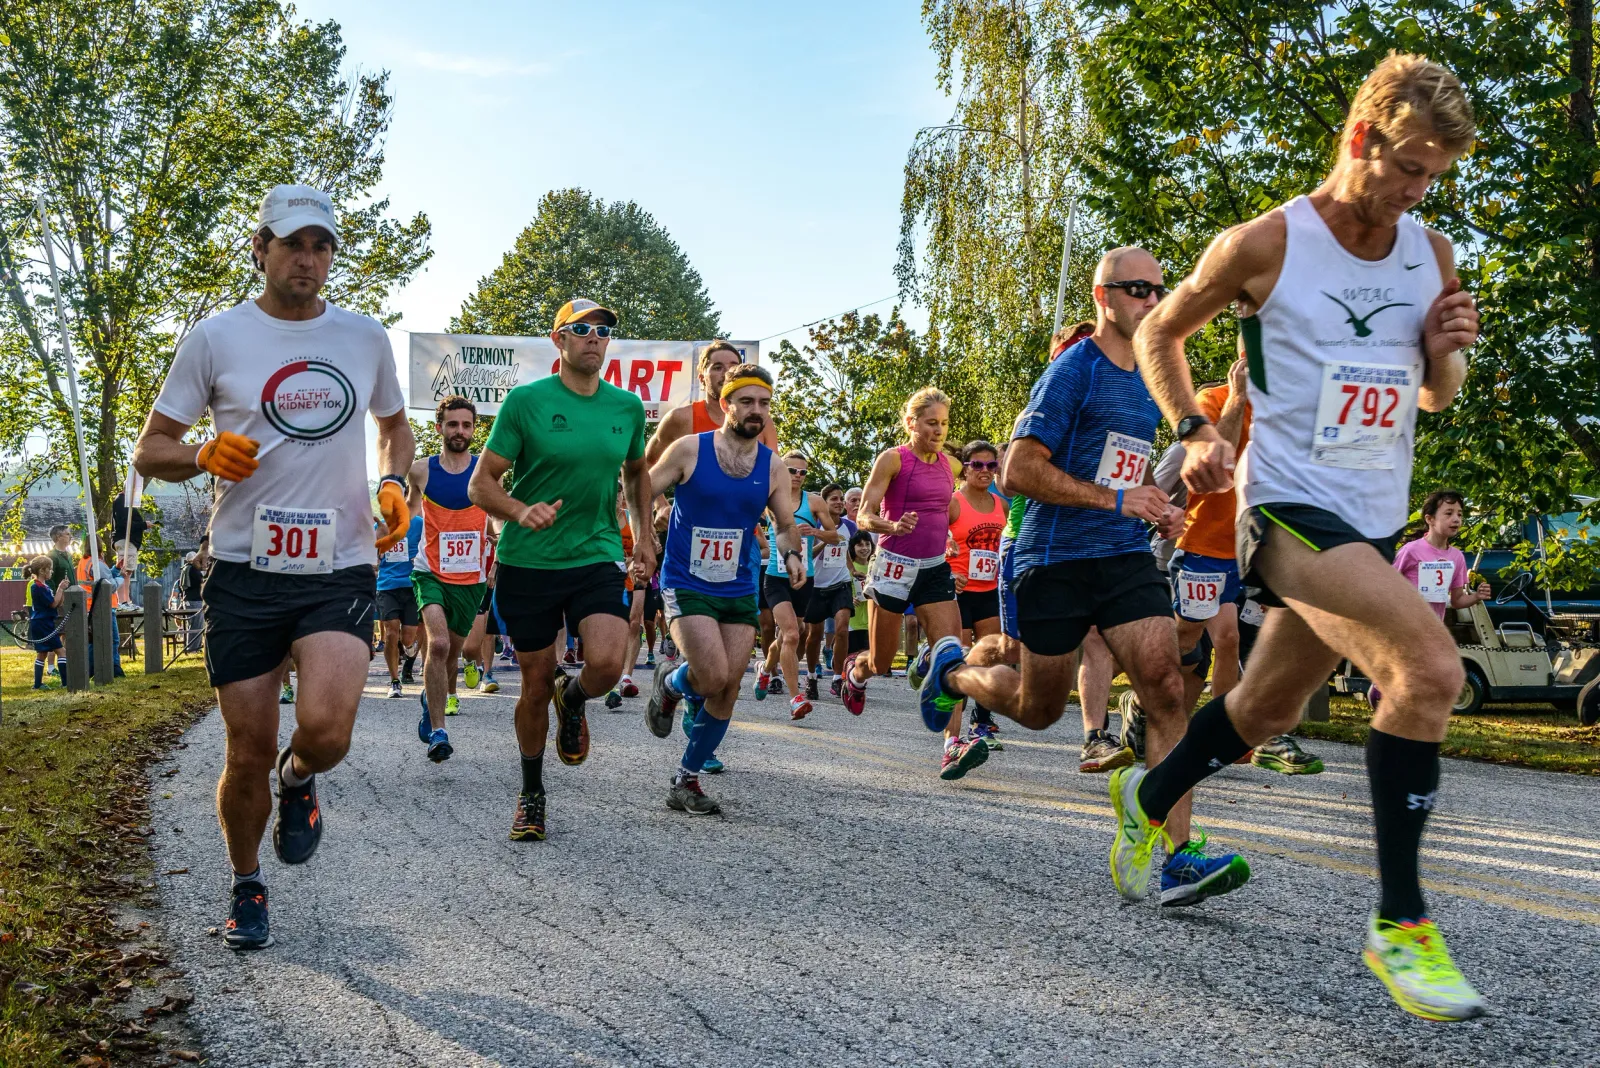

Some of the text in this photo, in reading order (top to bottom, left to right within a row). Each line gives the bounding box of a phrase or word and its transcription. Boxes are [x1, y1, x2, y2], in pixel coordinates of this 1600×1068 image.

[461, 346, 515, 366] VERMONT
[431, 353, 520, 390] Natural
[278, 392, 331, 401] HEALTHY
[278, 400, 342, 410] KIDNEY 10K
[1336, 384, 1399, 428] 792
[1110, 449, 1145, 484] 358
[266, 524, 319, 558] 301
[447, 540, 473, 557] 587
[700, 538, 733, 561] 716
[831, 547, 842, 557] 91
[883, 561, 904, 580] 18
[1435, 569, 1444, 586] 3
[1186, 582, 1217, 602] 103
